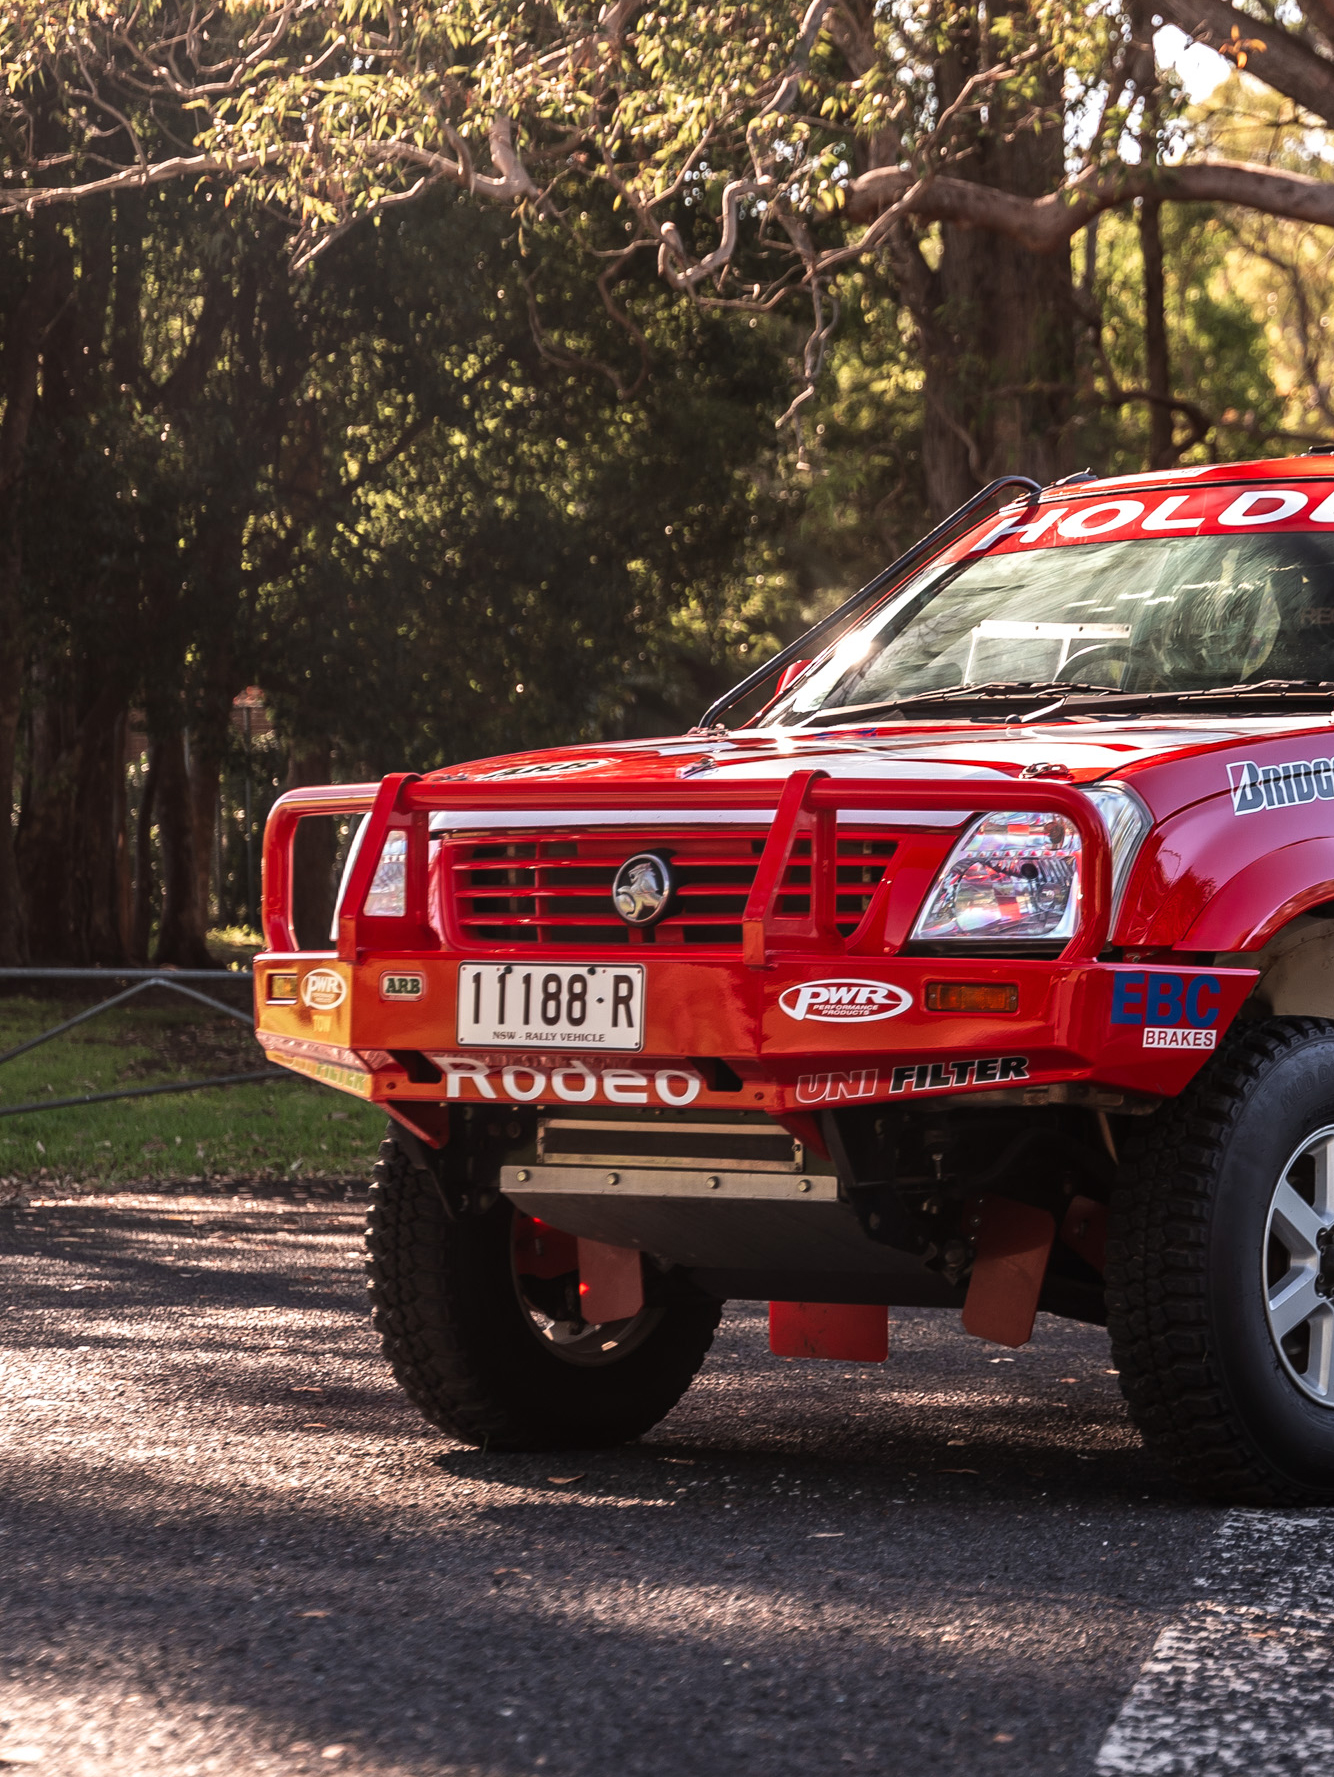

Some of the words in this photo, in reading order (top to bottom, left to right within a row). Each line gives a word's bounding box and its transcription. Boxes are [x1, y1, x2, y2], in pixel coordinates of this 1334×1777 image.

[385, 977, 421, 994] ARB
[1110, 971, 1221, 1028] EBC
[797, 986, 902, 1020] PWR
[492, 1031, 516, 1040] NSW
[525, 1032, 558, 1041] RALLY
[560, 1033, 606, 1042] VEHICLE
[1145, 1030, 1214, 1047] BRAKES
[431, 1057, 701, 1106] Rodeo
[795, 1069, 879, 1104] UNI
[889, 1056, 1030, 1094] FILTER
